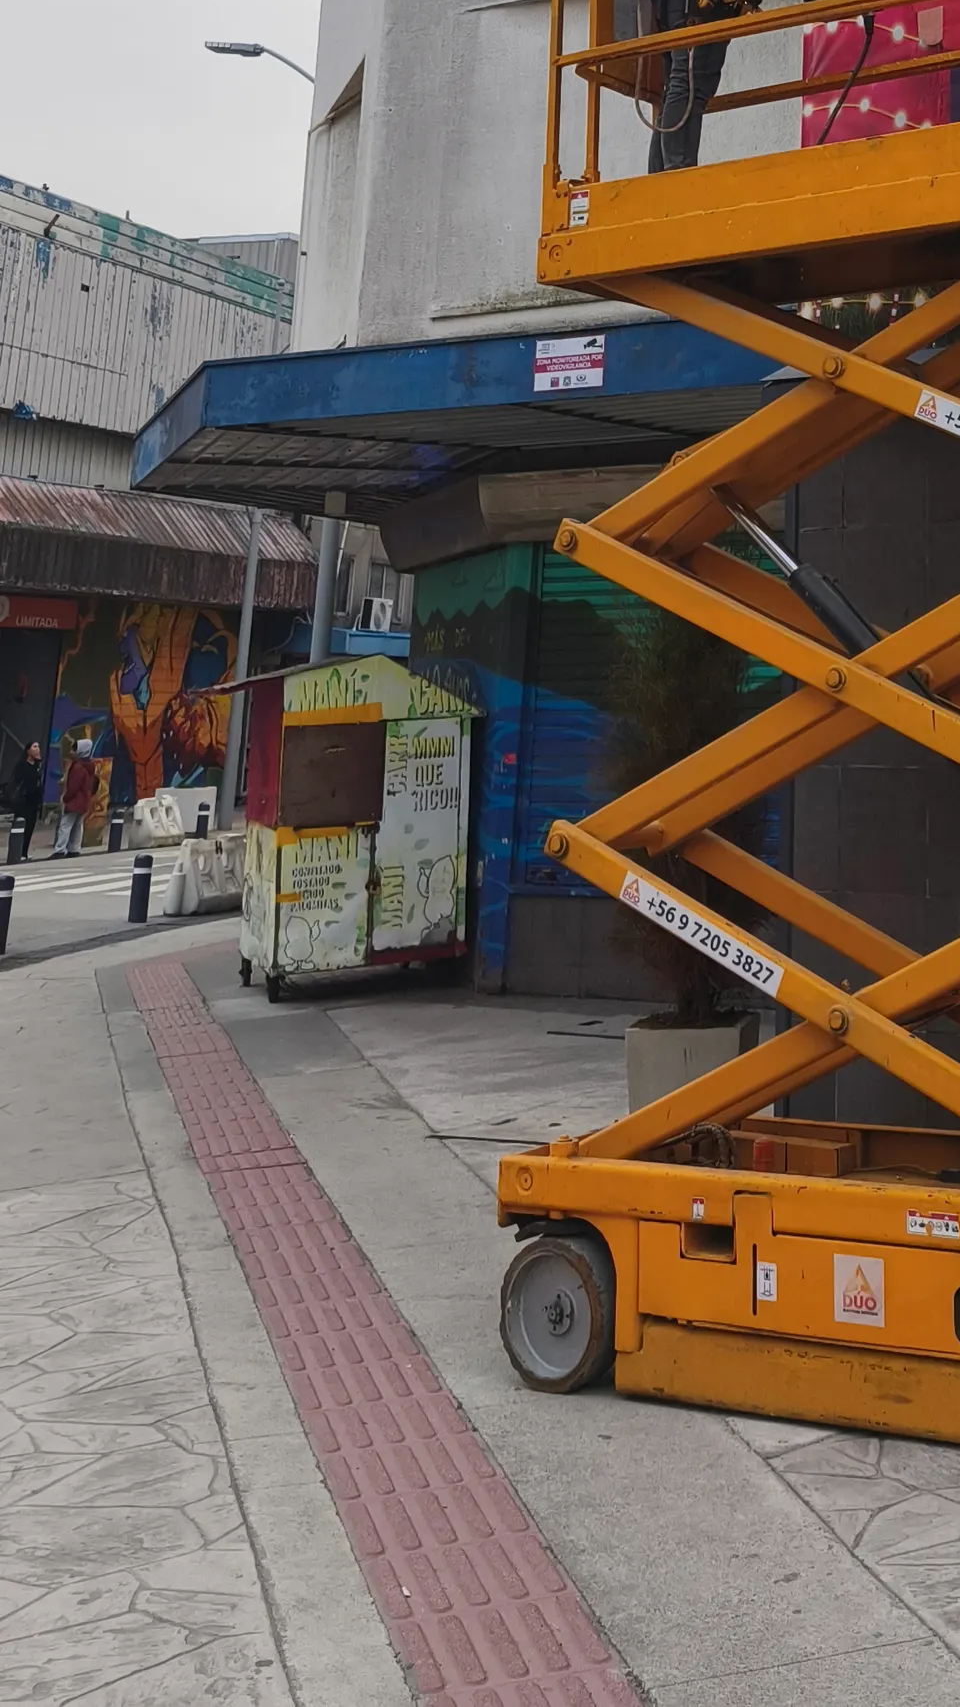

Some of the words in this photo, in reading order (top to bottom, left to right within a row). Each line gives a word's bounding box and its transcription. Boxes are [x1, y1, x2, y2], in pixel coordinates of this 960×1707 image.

[591, 353, 603, 361] POR
[15, 615, 58, 628] LIMITADA
[414, 736, 455, 760] MMM
[415, 763, 444, 788] QUE
[411, 787, 458, 812] RICO!!
[647, 896, 677, 924] +56
[678, 913, 689, 931] 9
[690, 921, 731, 958] 7205
[732, 947, 775, 984] 3827
